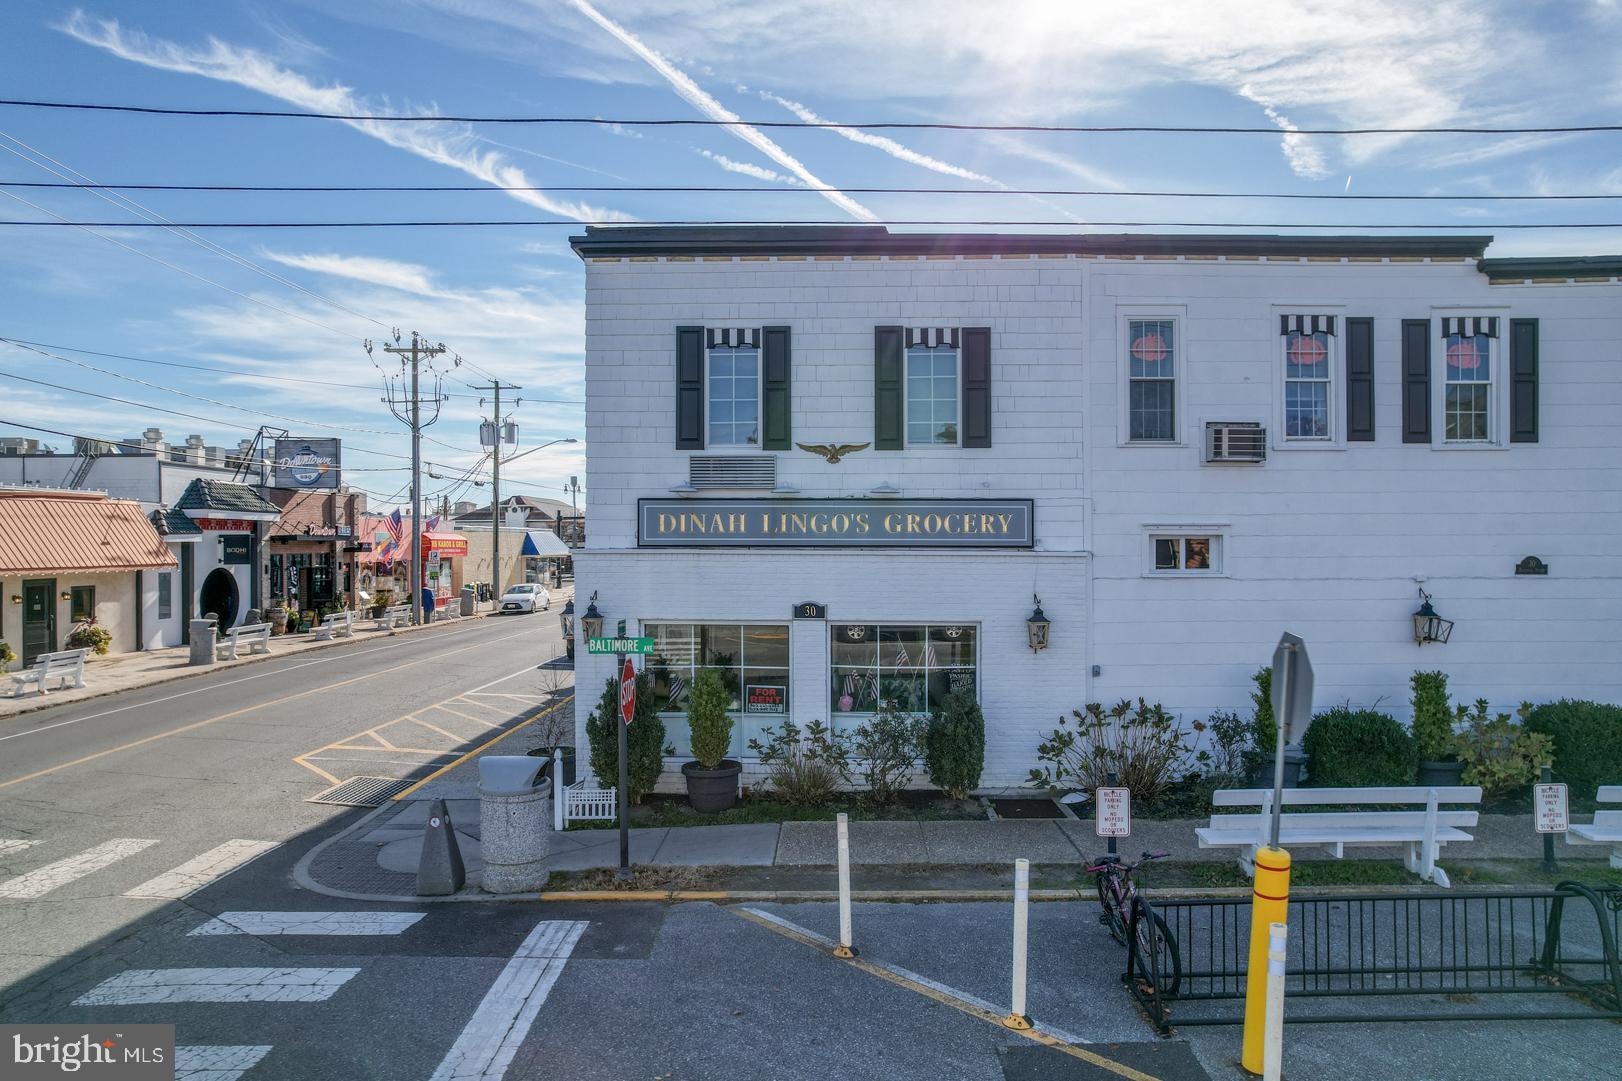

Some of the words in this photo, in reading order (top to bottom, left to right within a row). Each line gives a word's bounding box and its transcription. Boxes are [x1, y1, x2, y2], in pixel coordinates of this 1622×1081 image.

[658, 512, 747, 534] DINAH
[762, 512, 870, 534] LINGO'S
[884, 512, 1014, 534] GROCERY
[804, 605, 816, 617] 30
[589, 640, 639, 652] BALTIMORE
[622, 677, 635, 706] STOP
[755, 688, 777, 696] FOR
[750, 696, 782, 704] RENT
